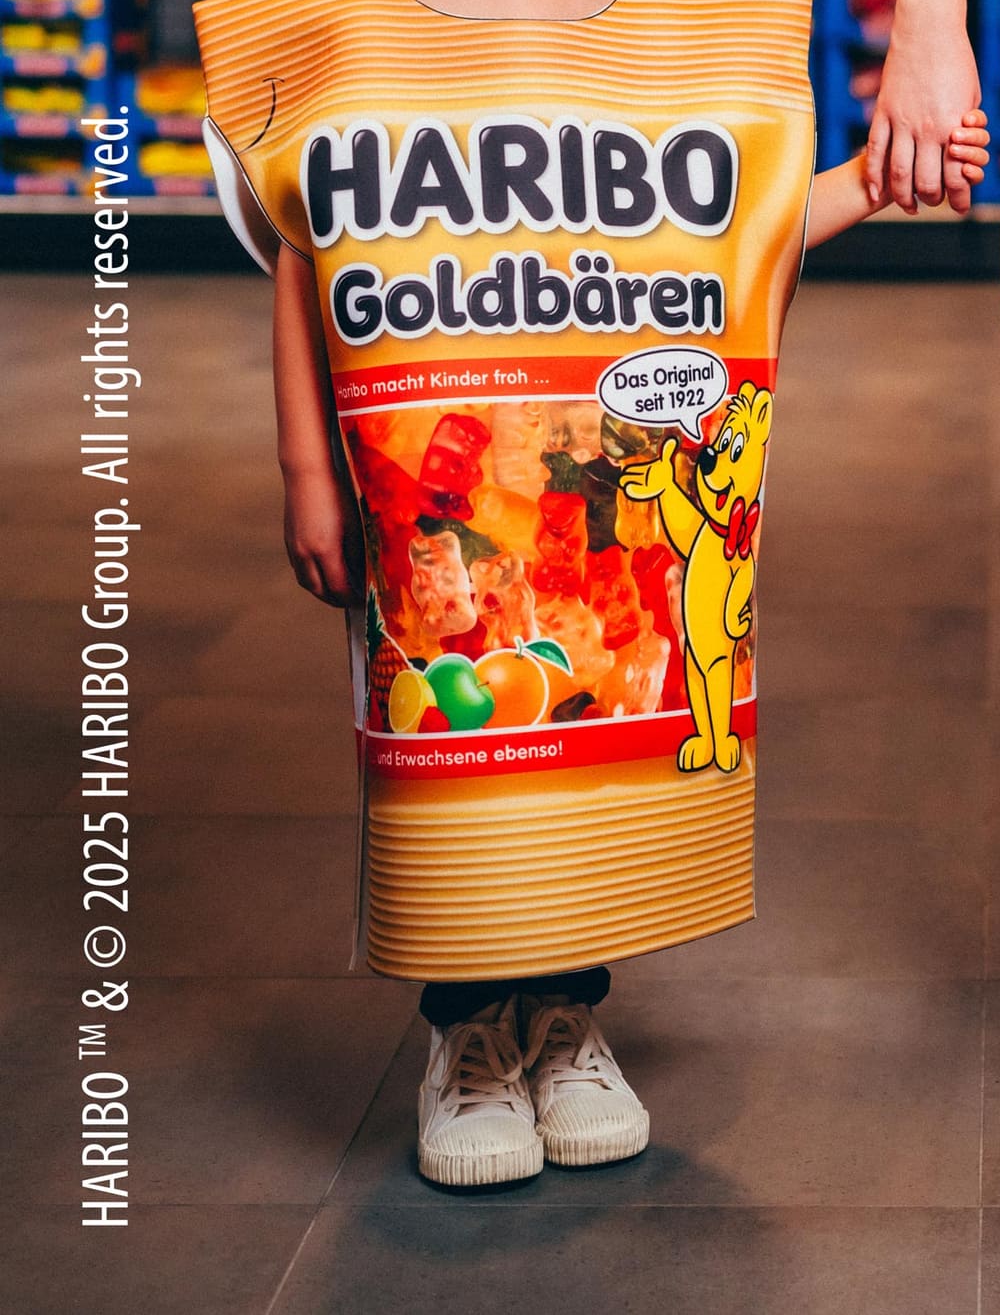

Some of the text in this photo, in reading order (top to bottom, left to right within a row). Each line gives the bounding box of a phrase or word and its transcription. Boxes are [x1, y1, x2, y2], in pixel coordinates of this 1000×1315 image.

[307, 123, 734, 238] HARIBO
[332, 255, 723, 340] Goldbären
[372, 374, 425, 395] macht
[430, 370, 488, 388] Kinder
[493, 368, 528, 385] froh
[613, 360, 714, 390] Das Original
[634, 387, 705, 413] seit 1922
[377, 739, 564, 767] und Erwachsene ebenso!
